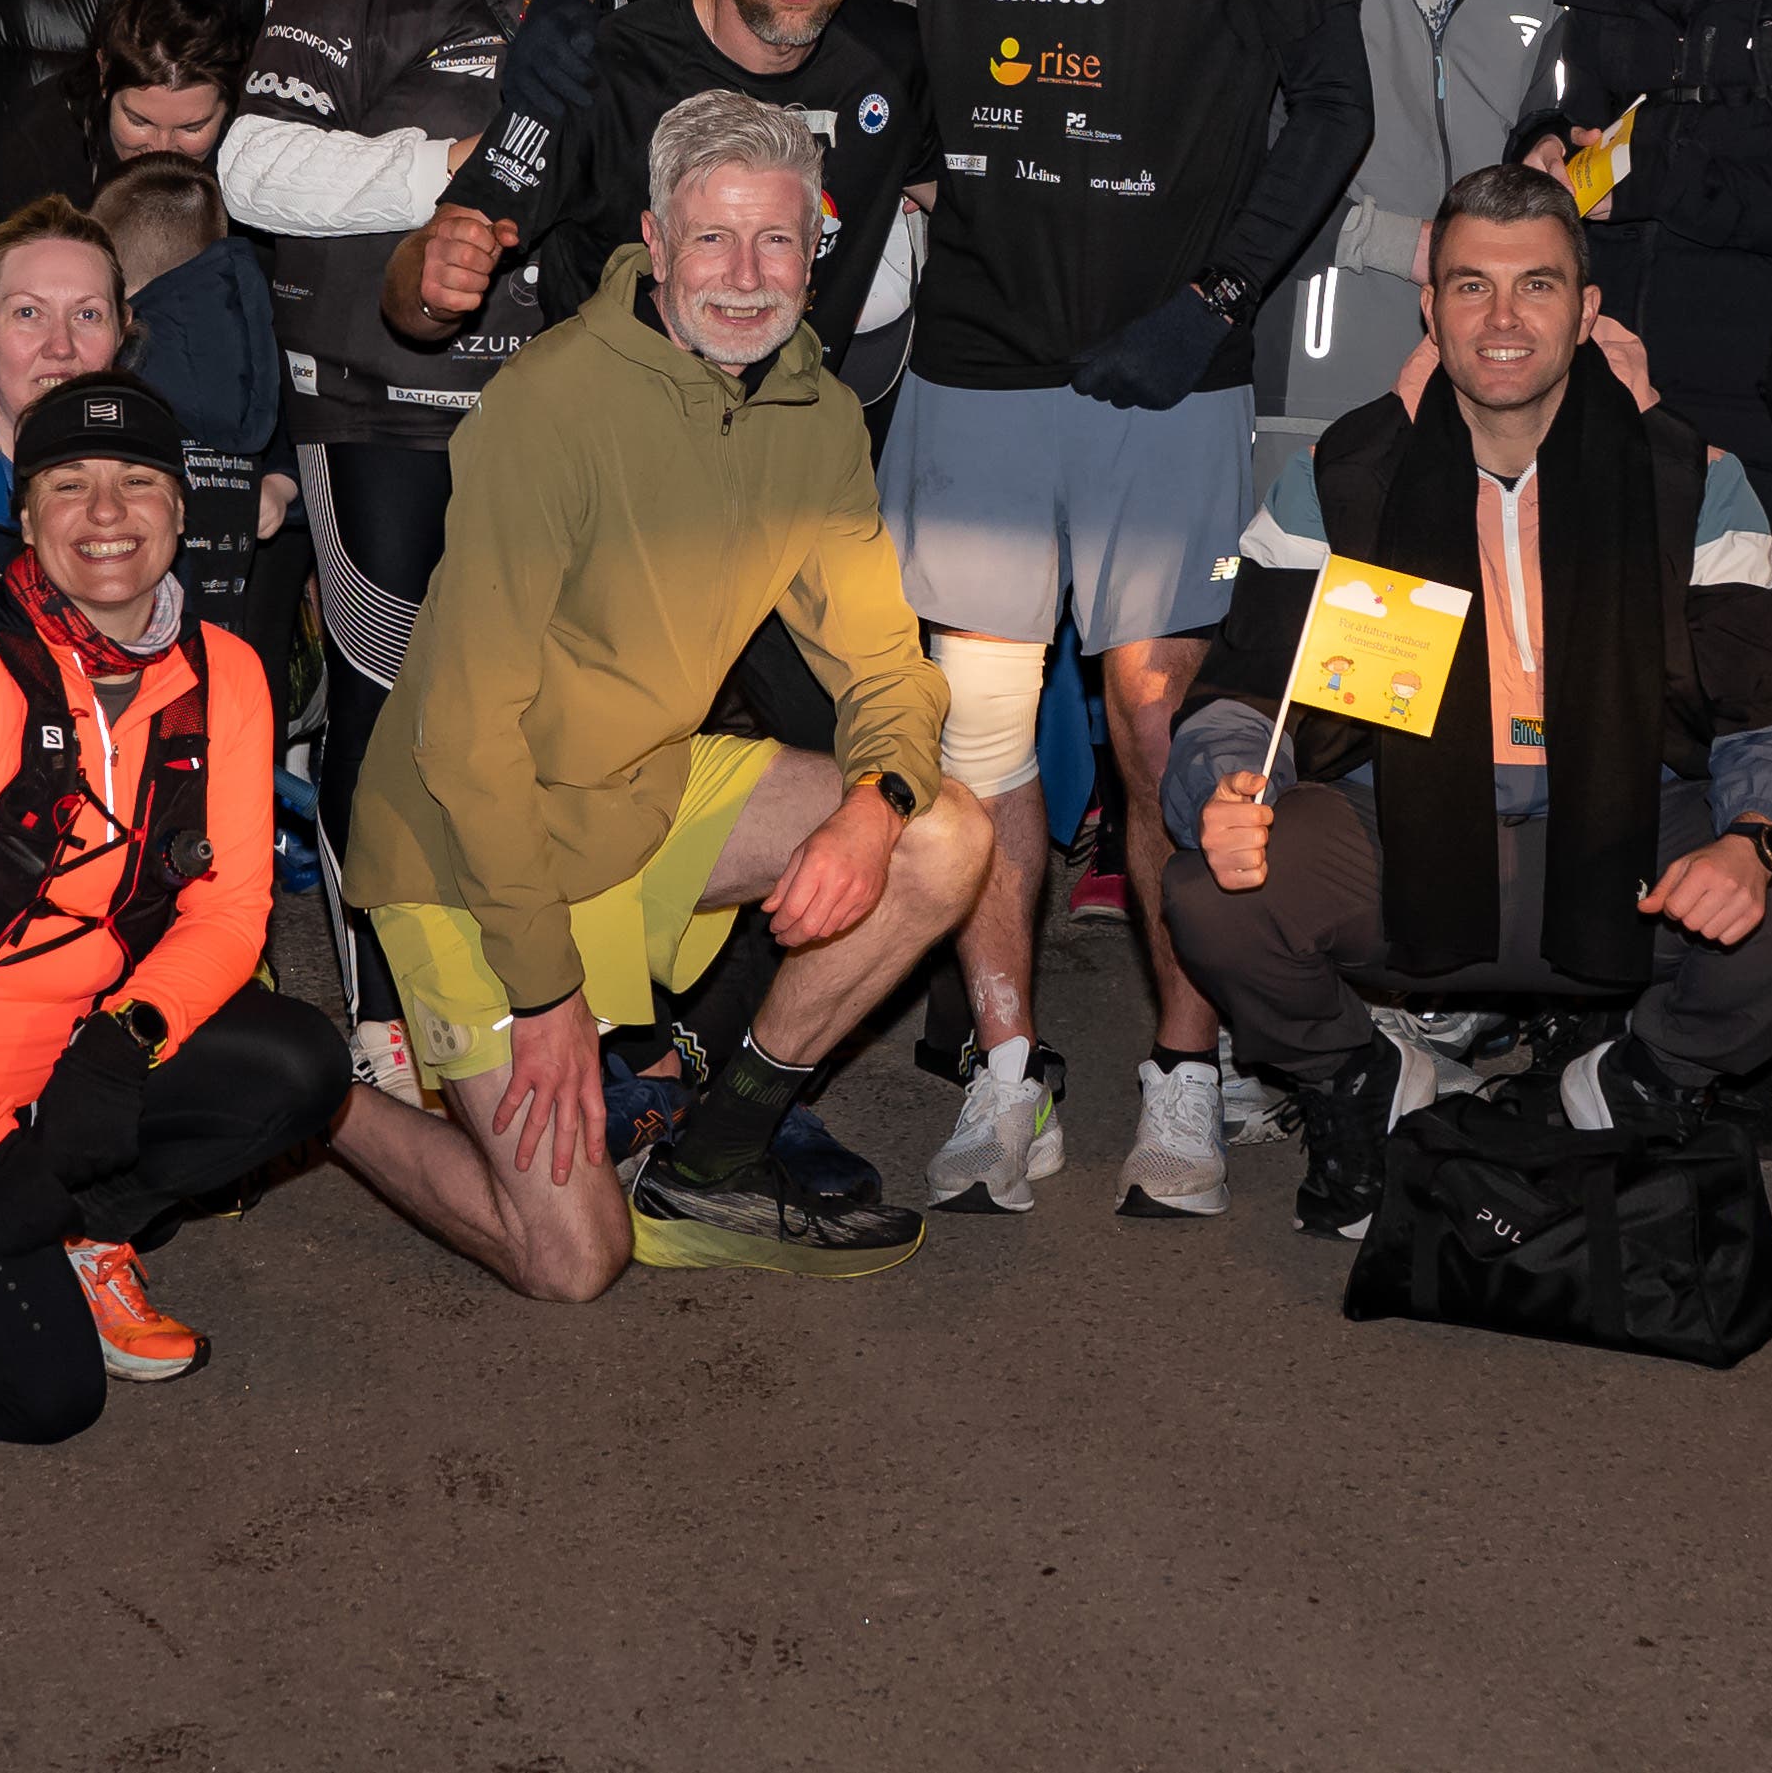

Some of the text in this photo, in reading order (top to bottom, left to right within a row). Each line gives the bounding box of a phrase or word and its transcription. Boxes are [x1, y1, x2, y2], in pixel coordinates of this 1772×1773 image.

[1040, 41, 1102, 79] rise
[971, 106, 1023, 124] AZURE
[1065, 127, 1094, 139] Peacock
[1095, 130, 1123, 141] Stevens
[1015, 159, 1061, 184] Melius
[1090, 176, 1156, 192] ian williams
[395, 389, 477, 407] BATHGATE
[1339, 617, 1354, 630] For
[1362, 624, 1393, 640] future
[1393, 633, 1431, 650] without
[1343, 633, 1417, 661] domestic abuse
